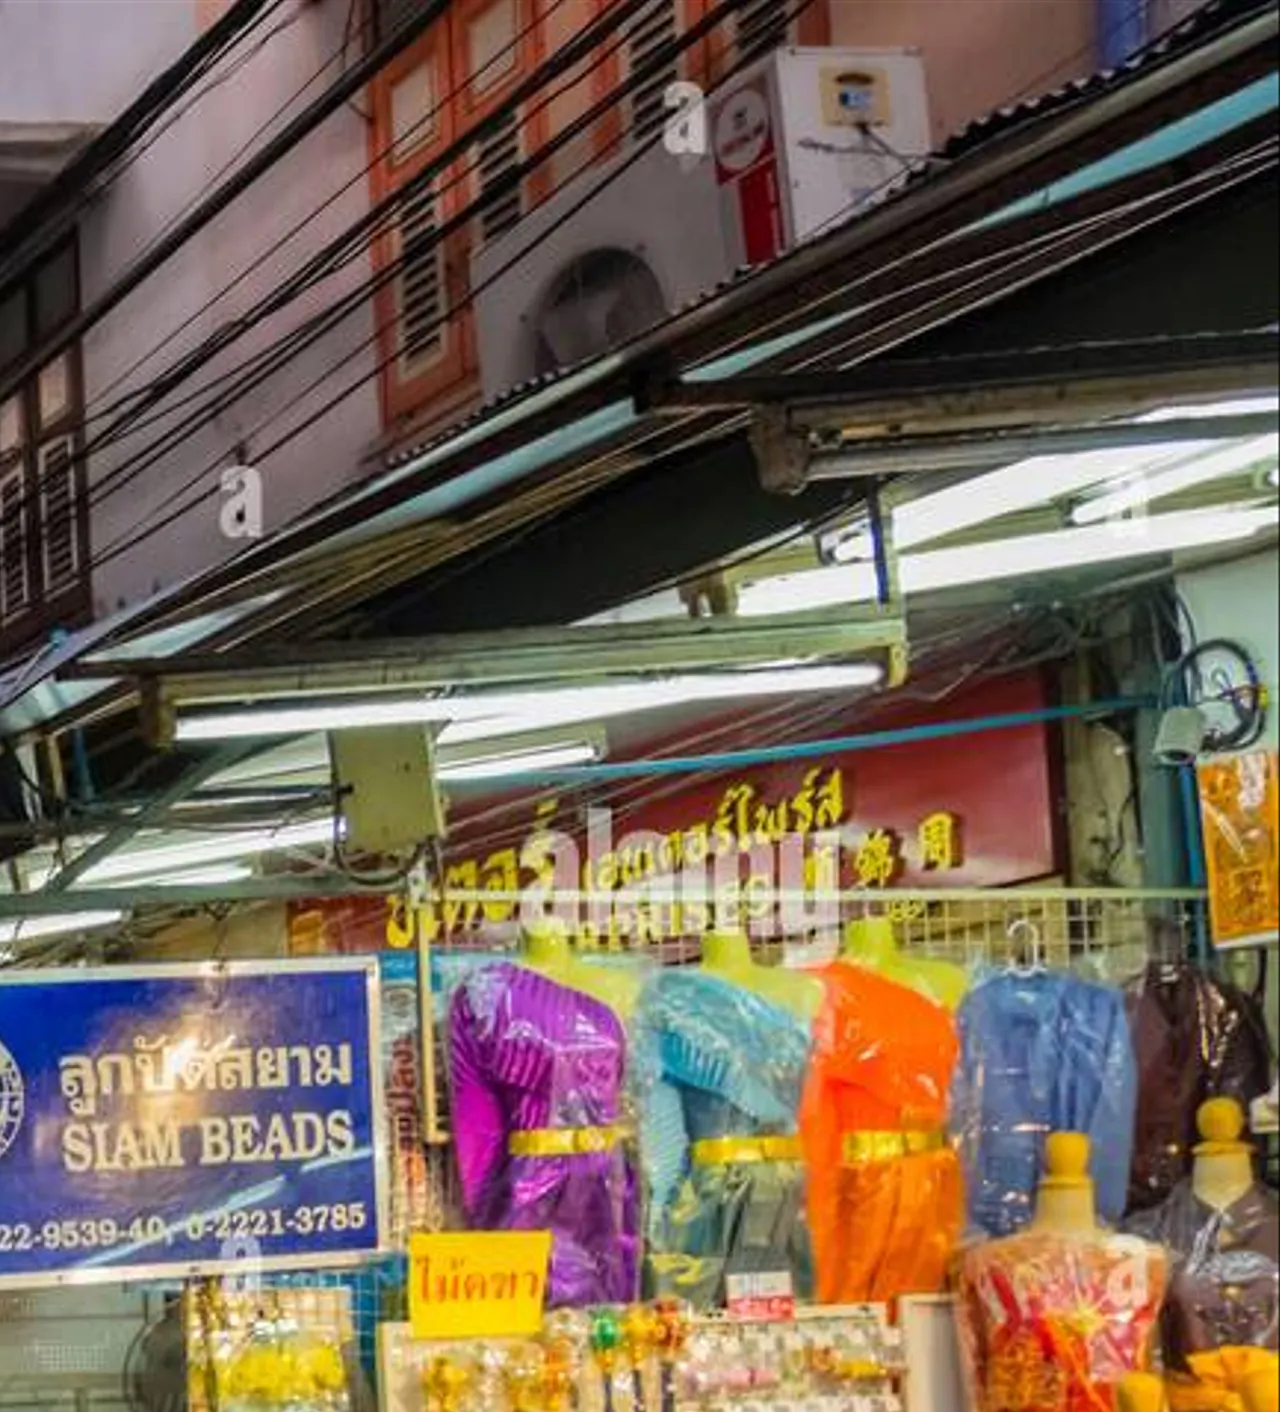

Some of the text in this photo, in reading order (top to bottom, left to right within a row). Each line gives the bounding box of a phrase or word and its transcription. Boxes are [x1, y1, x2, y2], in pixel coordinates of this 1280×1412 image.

[58, 1034, 352, 1116] ลูกปัดสยาม
[62, 1109, 355, 1173] SIAM BEADS
